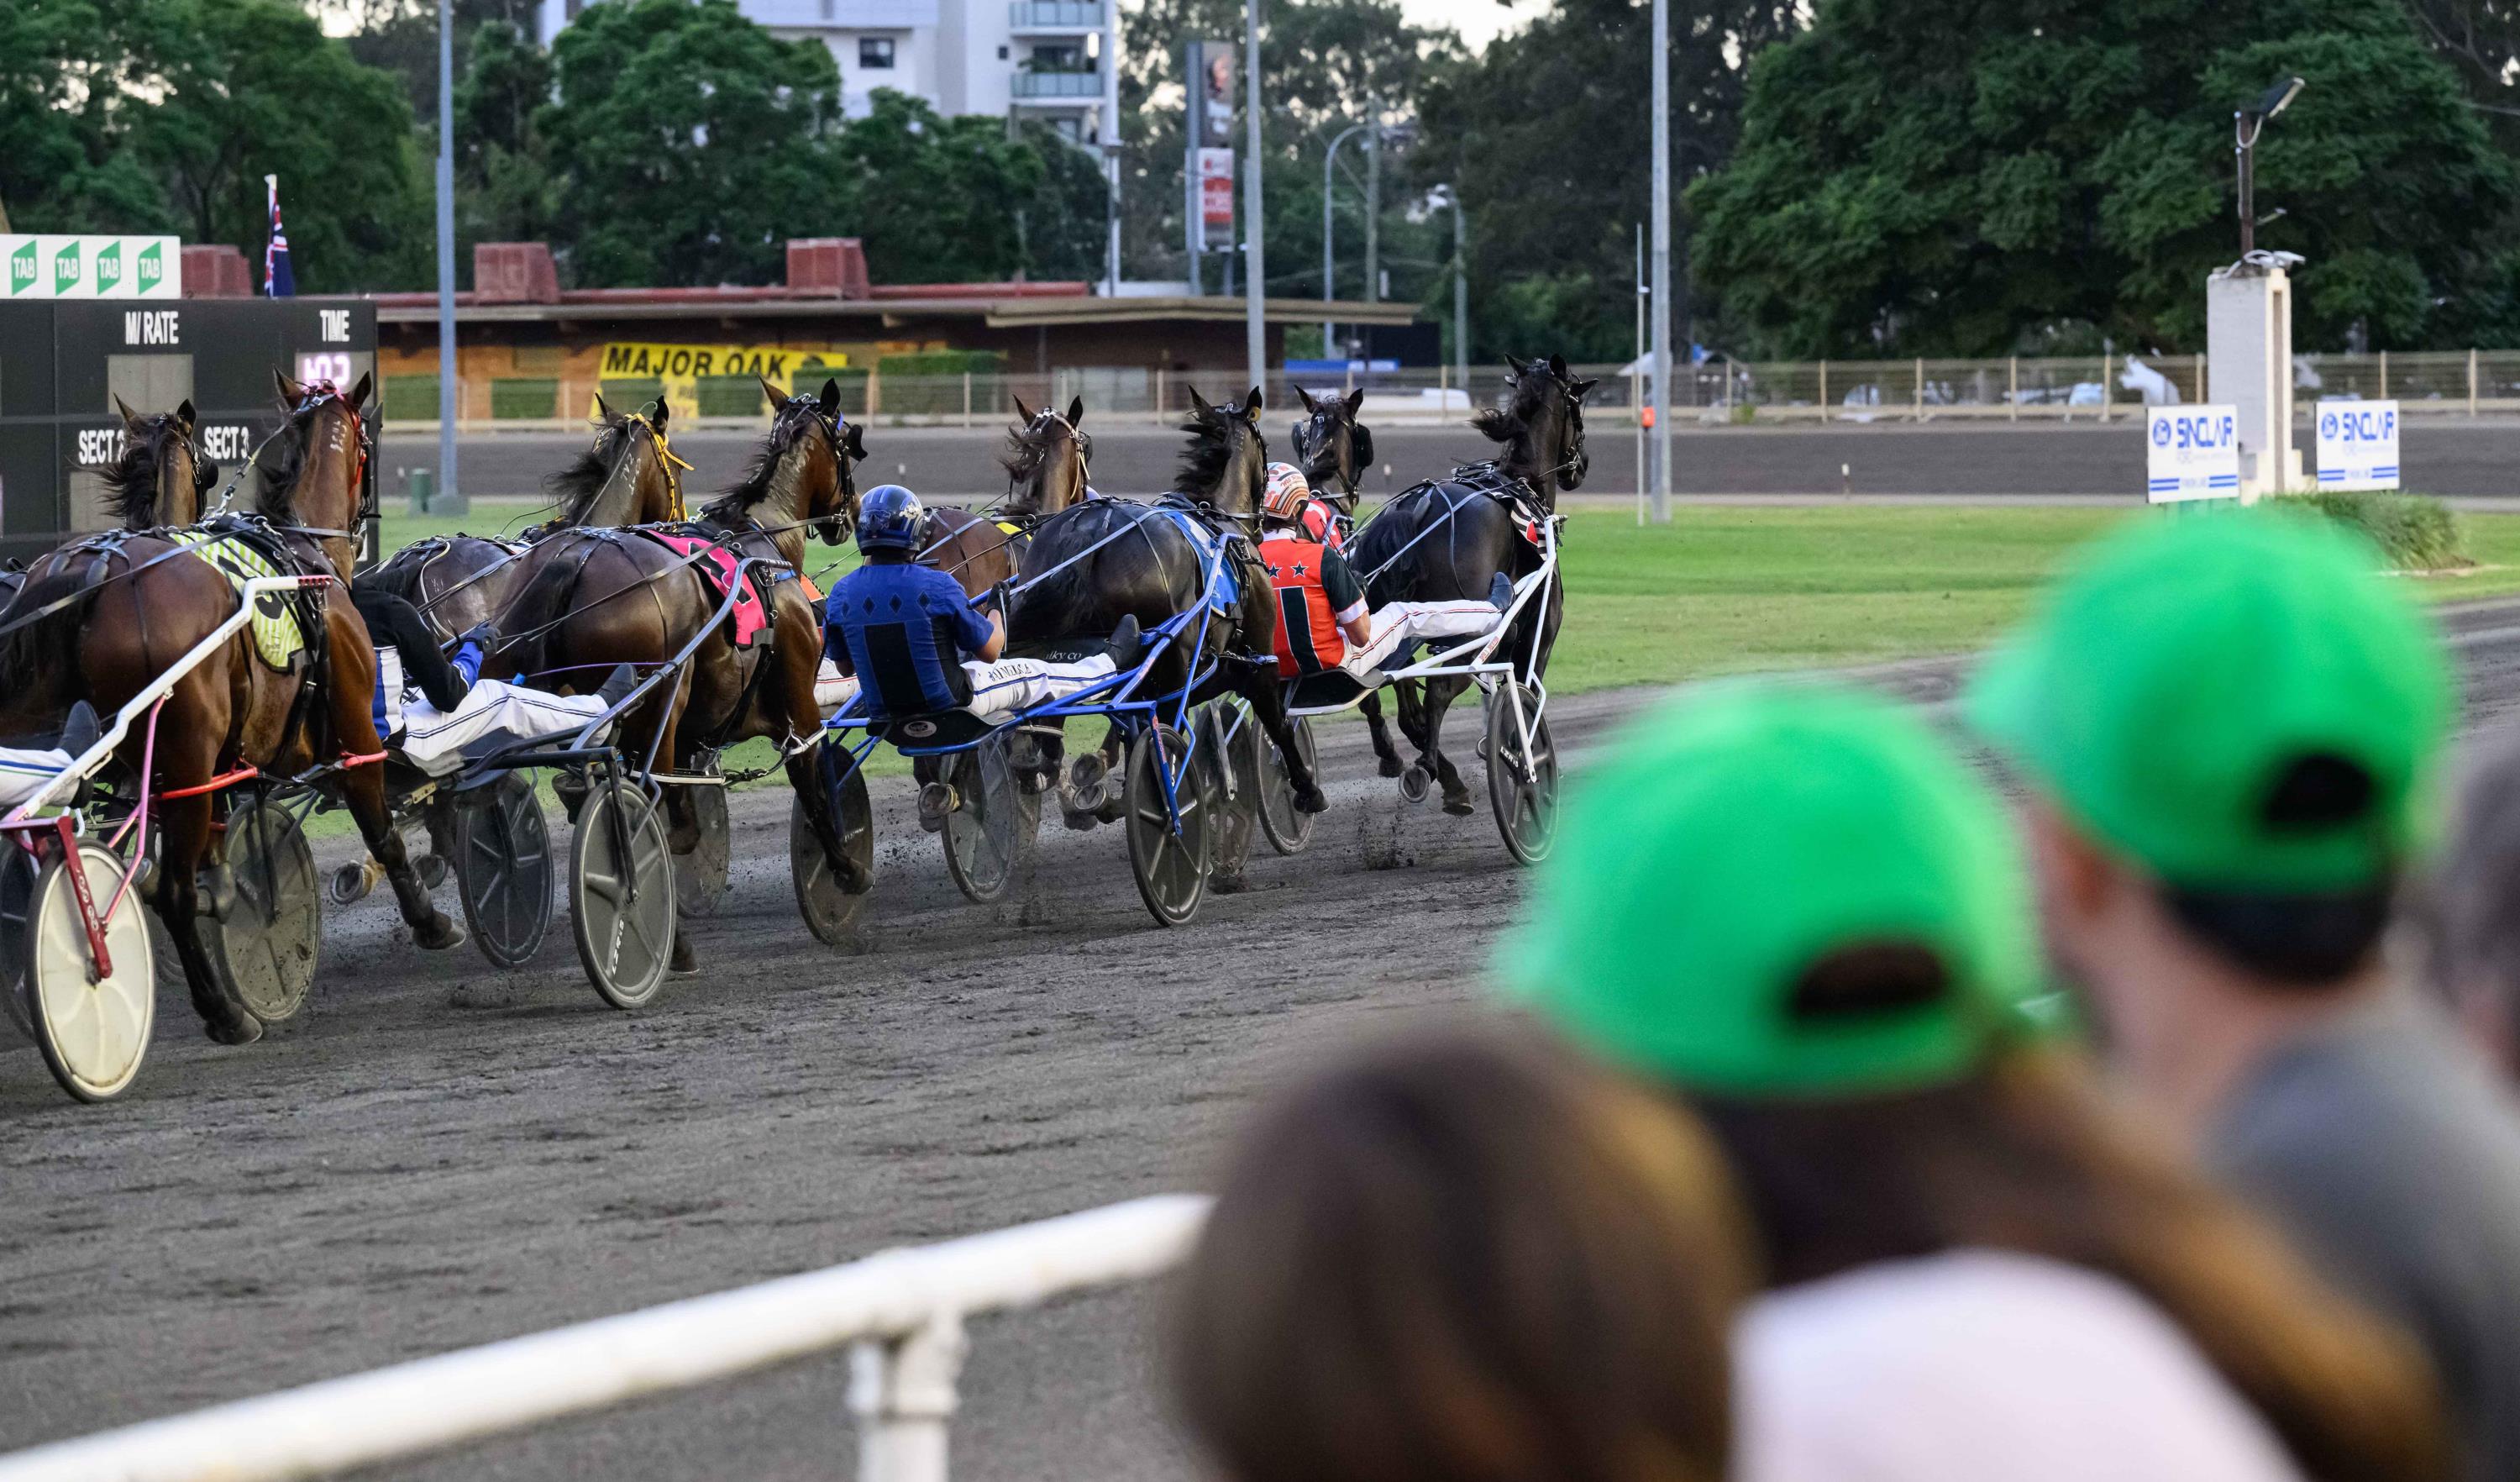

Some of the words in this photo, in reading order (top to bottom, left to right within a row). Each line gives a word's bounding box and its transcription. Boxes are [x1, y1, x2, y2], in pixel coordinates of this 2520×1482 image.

[13, 257, 35, 279] TAB
[57, 258, 78, 279] TAB
[98, 257, 119, 279] TAB
[139, 258, 160, 279] TAB
[143, 311, 179, 344] RATE
[319, 309, 350, 342] TIME
[606, 346, 713, 376] MAJOR
[725, 352, 786, 380] OAK
[78, 429, 115, 464] SECT
[204, 426, 239, 460] SECT
[241, 426, 249, 458] 3
